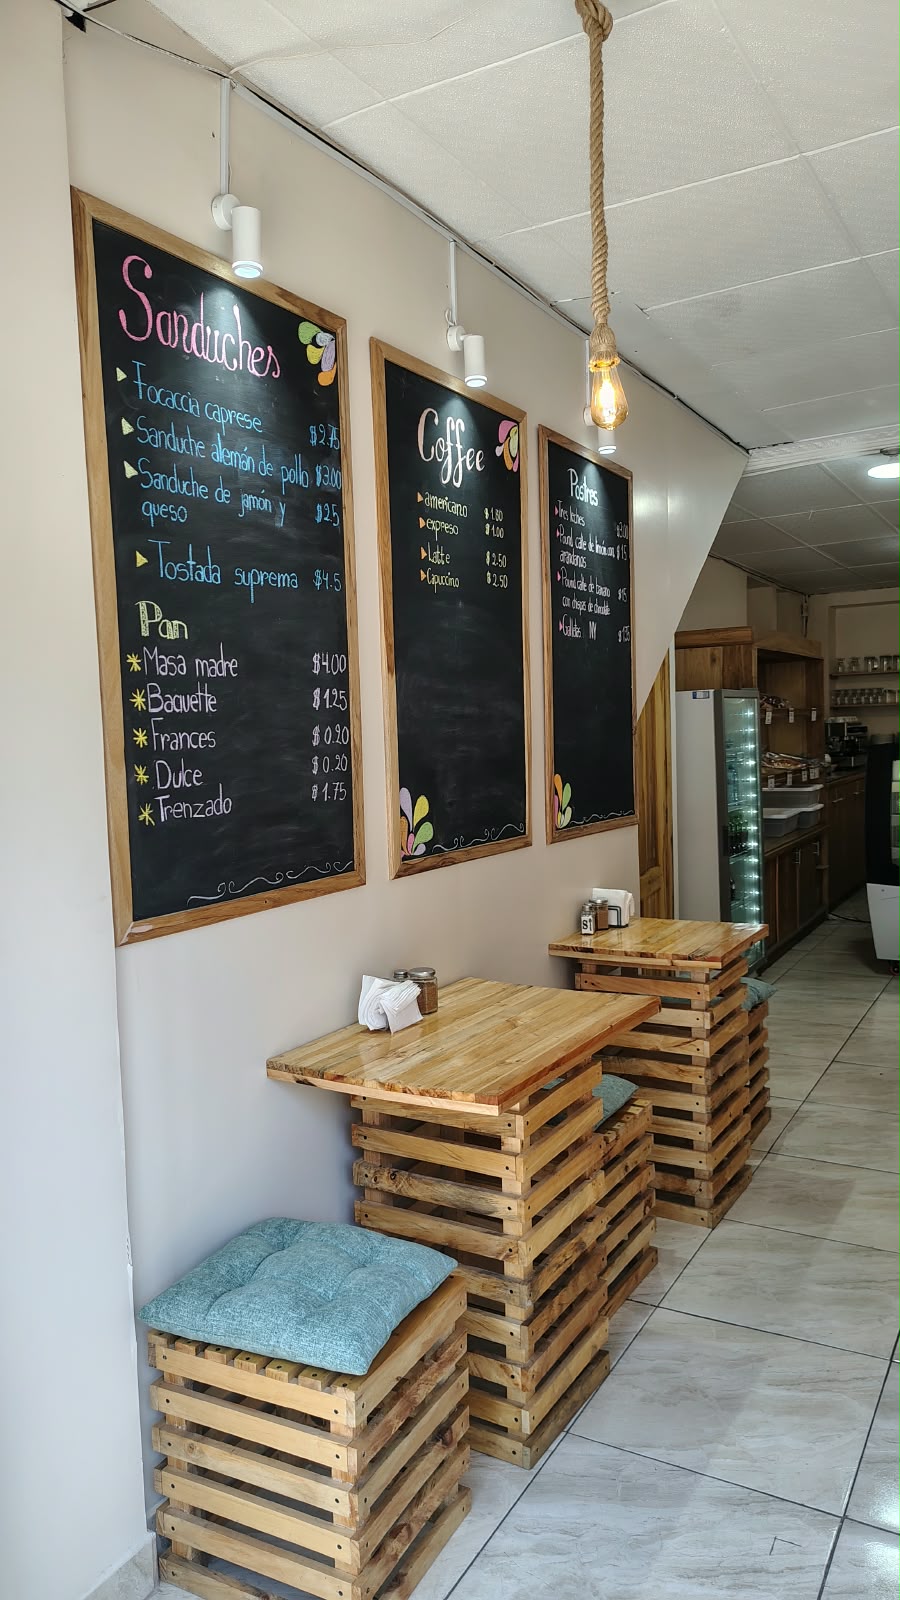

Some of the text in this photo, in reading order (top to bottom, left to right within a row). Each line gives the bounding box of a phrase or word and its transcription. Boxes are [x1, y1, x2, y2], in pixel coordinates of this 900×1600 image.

[118, 255, 281, 379] Sanduches
[132, 360, 200, 418] Focaccia
[204, 402, 263, 436] caprese
[136, 415, 205, 459] Sanduche
[211, 432, 255, 475] alemán
[258, 444, 274, 477] de
[281, 453, 309, 495] pollo
[417, 407, 485, 488] Coffee
[137, 457, 209, 500] Sanduche
[214, 475, 231, 504] de
[238, 489, 272, 517] jamón
[279, 501, 287, 528] y
[424, 491, 468, 518] americano
[567, 468, 599, 507] Postres
[141, 500, 188, 528] queso
[426, 517, 459, 541] expreso
[557, 499, 569, 521] Tres
[569, 505, 586, 527] leches
[148, 539, 221, 585] Tostada
[234, 567, 299, 604] suprema
[427, 541, 451, 565] Latte
[426, 567, 460, 594] Capuccino
[135, 600, 189, 640] Pan
[143, 646, 187, 677] Masa
[195, 641, 239, 678] madre
[151, 717, 217, 752] Frances
[155, 758, 204, 790] Dulce
[154, 783, 232, 822] Trenzado
